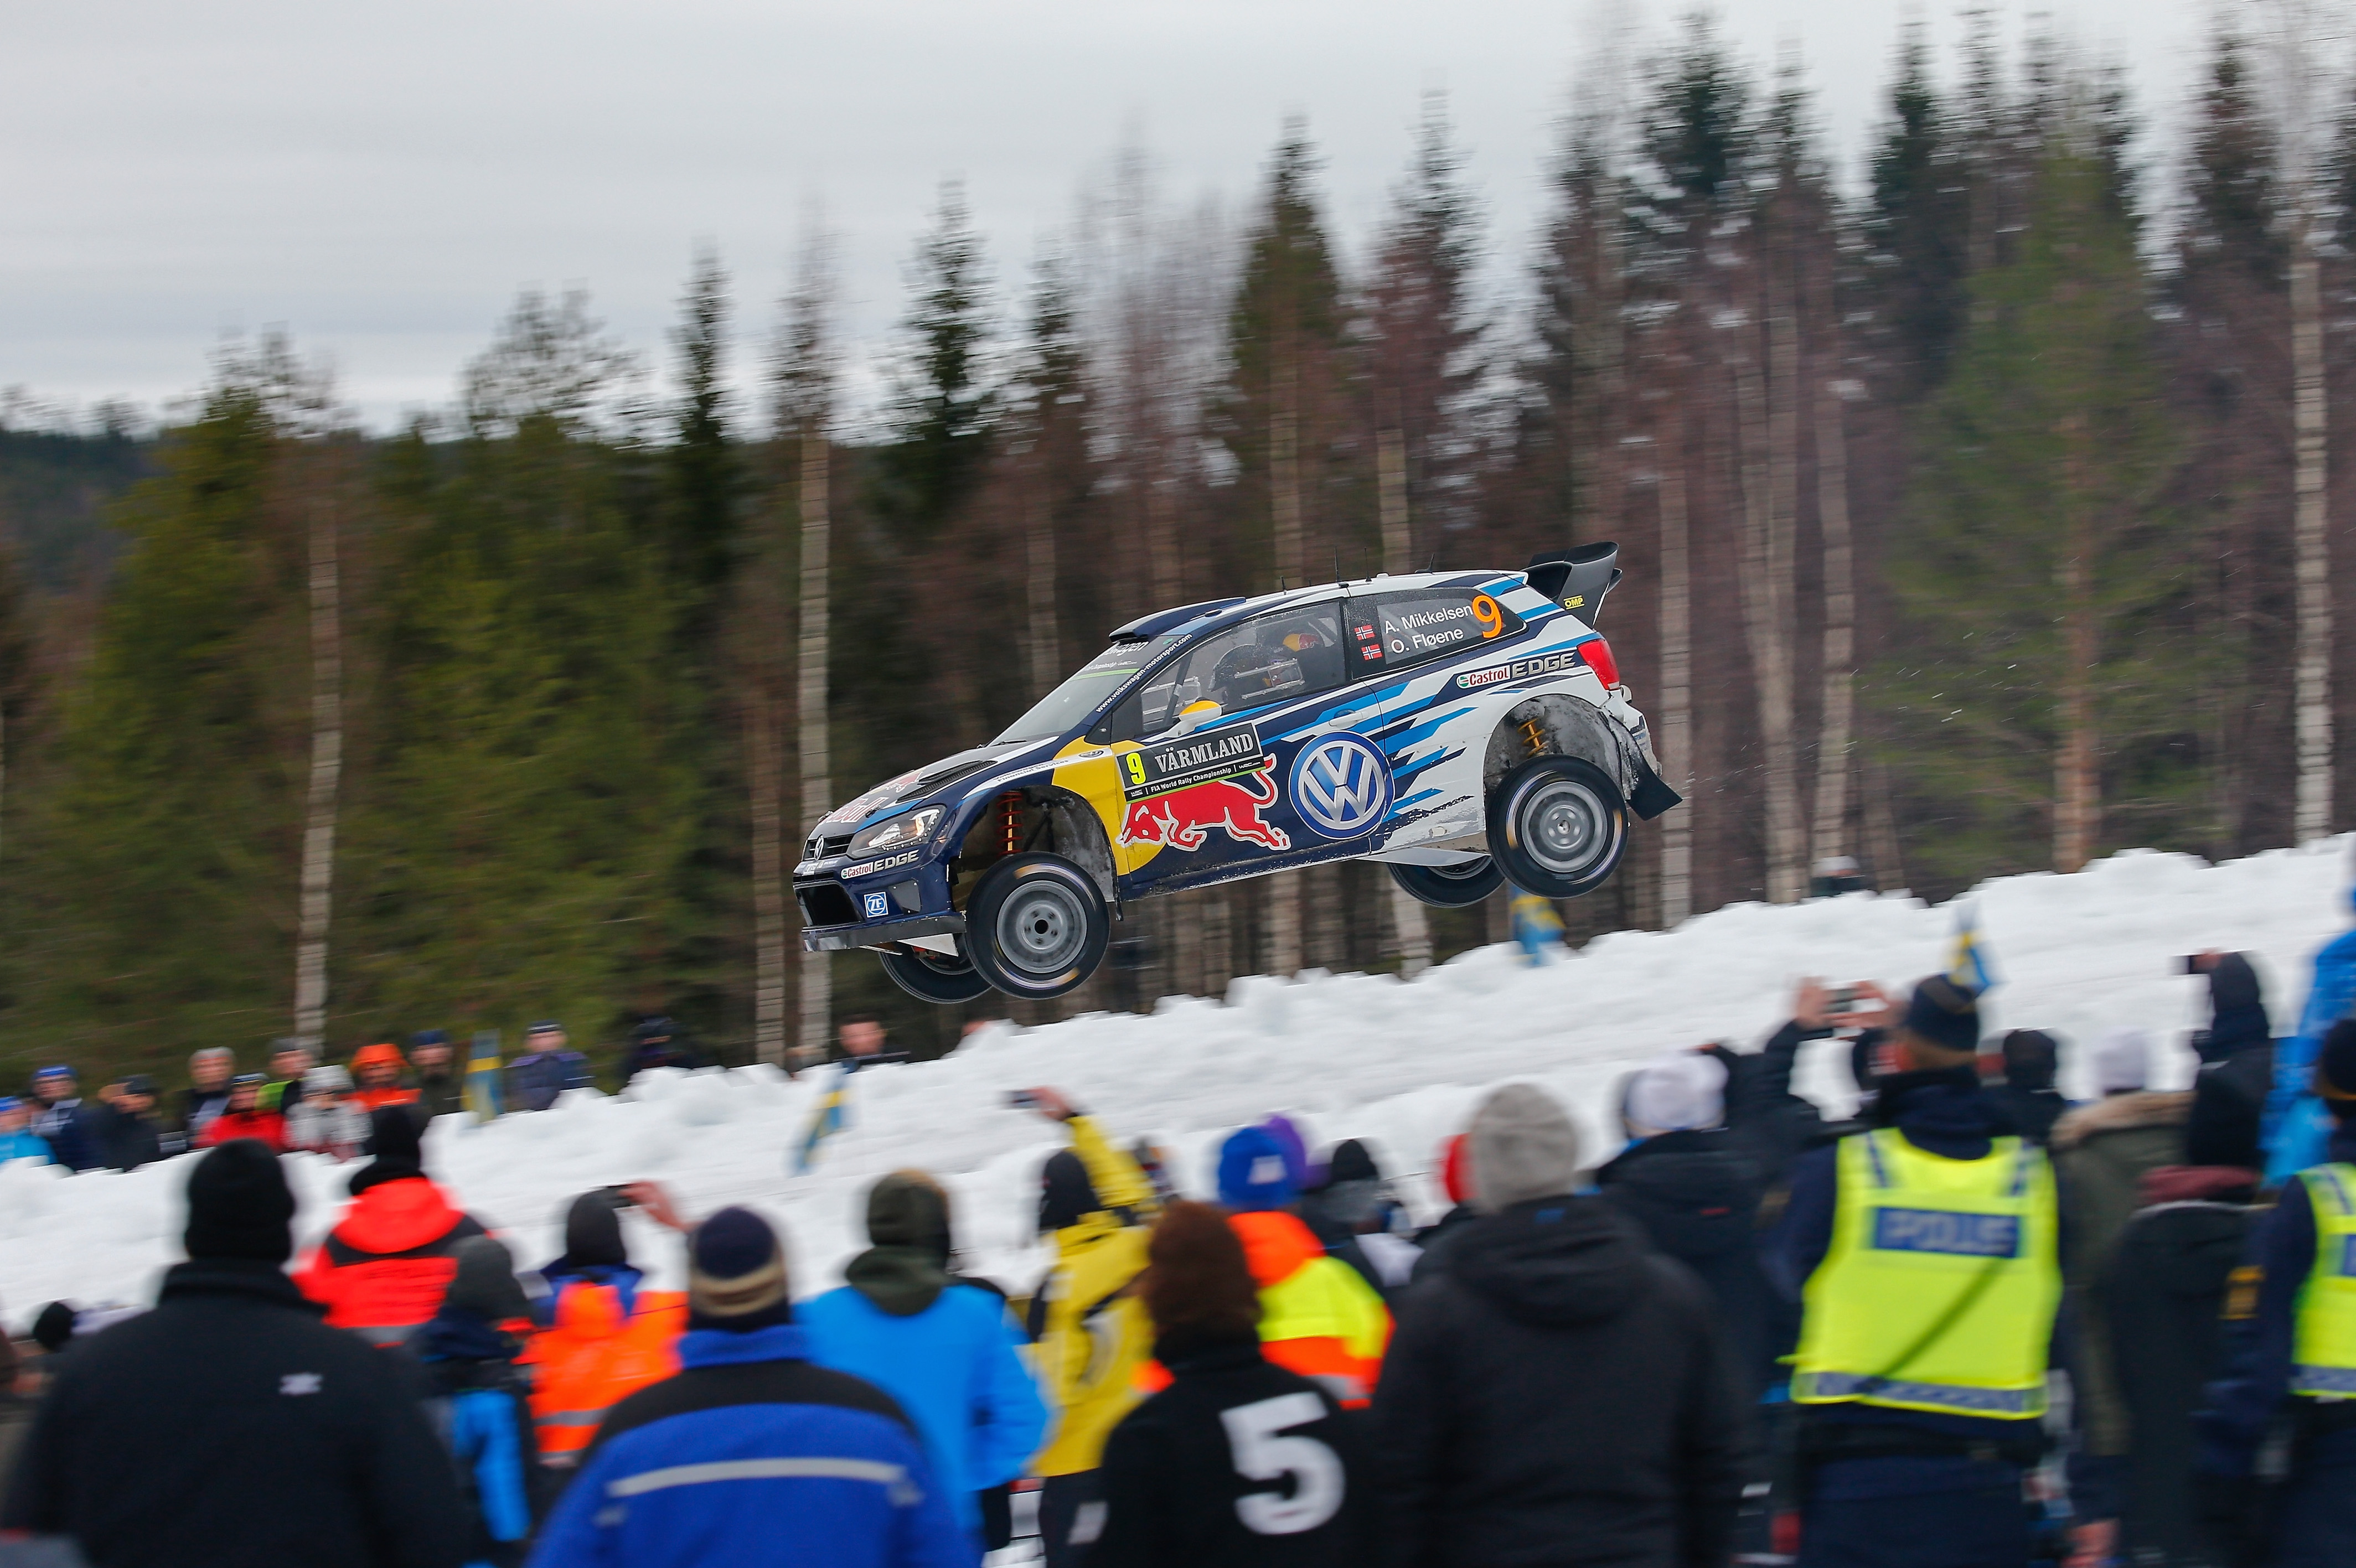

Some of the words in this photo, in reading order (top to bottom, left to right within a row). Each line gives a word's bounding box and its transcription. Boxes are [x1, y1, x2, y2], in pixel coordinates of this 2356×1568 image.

[1472, 594, 1502, 638] 9
[1564, 597, 1583, 608] OMP
[1384, 620, 1399, 634] A.
[1401, 605, 1474, 630] Mikkelsen
[1391, 639, 1410, 653] O.
[1412, 628, 1464, 649] Fløene
[1096, 633, 1192, 713] www.volkswagen-motorsport.com
[1470, 667, 1508, 686] Castrol
[1512, 652, 1576, 679] EDGE
[998, 769, 1034, 782] Financial
[1035, 760, 1069, 769] Services
[1125, 752, 1146, 785] 9
[1154, 733, 1253, 773] VÄRMLAND
[1160, 780, 1177, 790] World
[1178, 776, 1192, 787] Rally
[1193, 767, 1232, 781] Championship
[848, 863, 871, 877] Castrol
[874, 849, 919, 872] EDGE
[868, 898, 883, 911] ZF
[1219, 1391, 1346, 1535] 5
